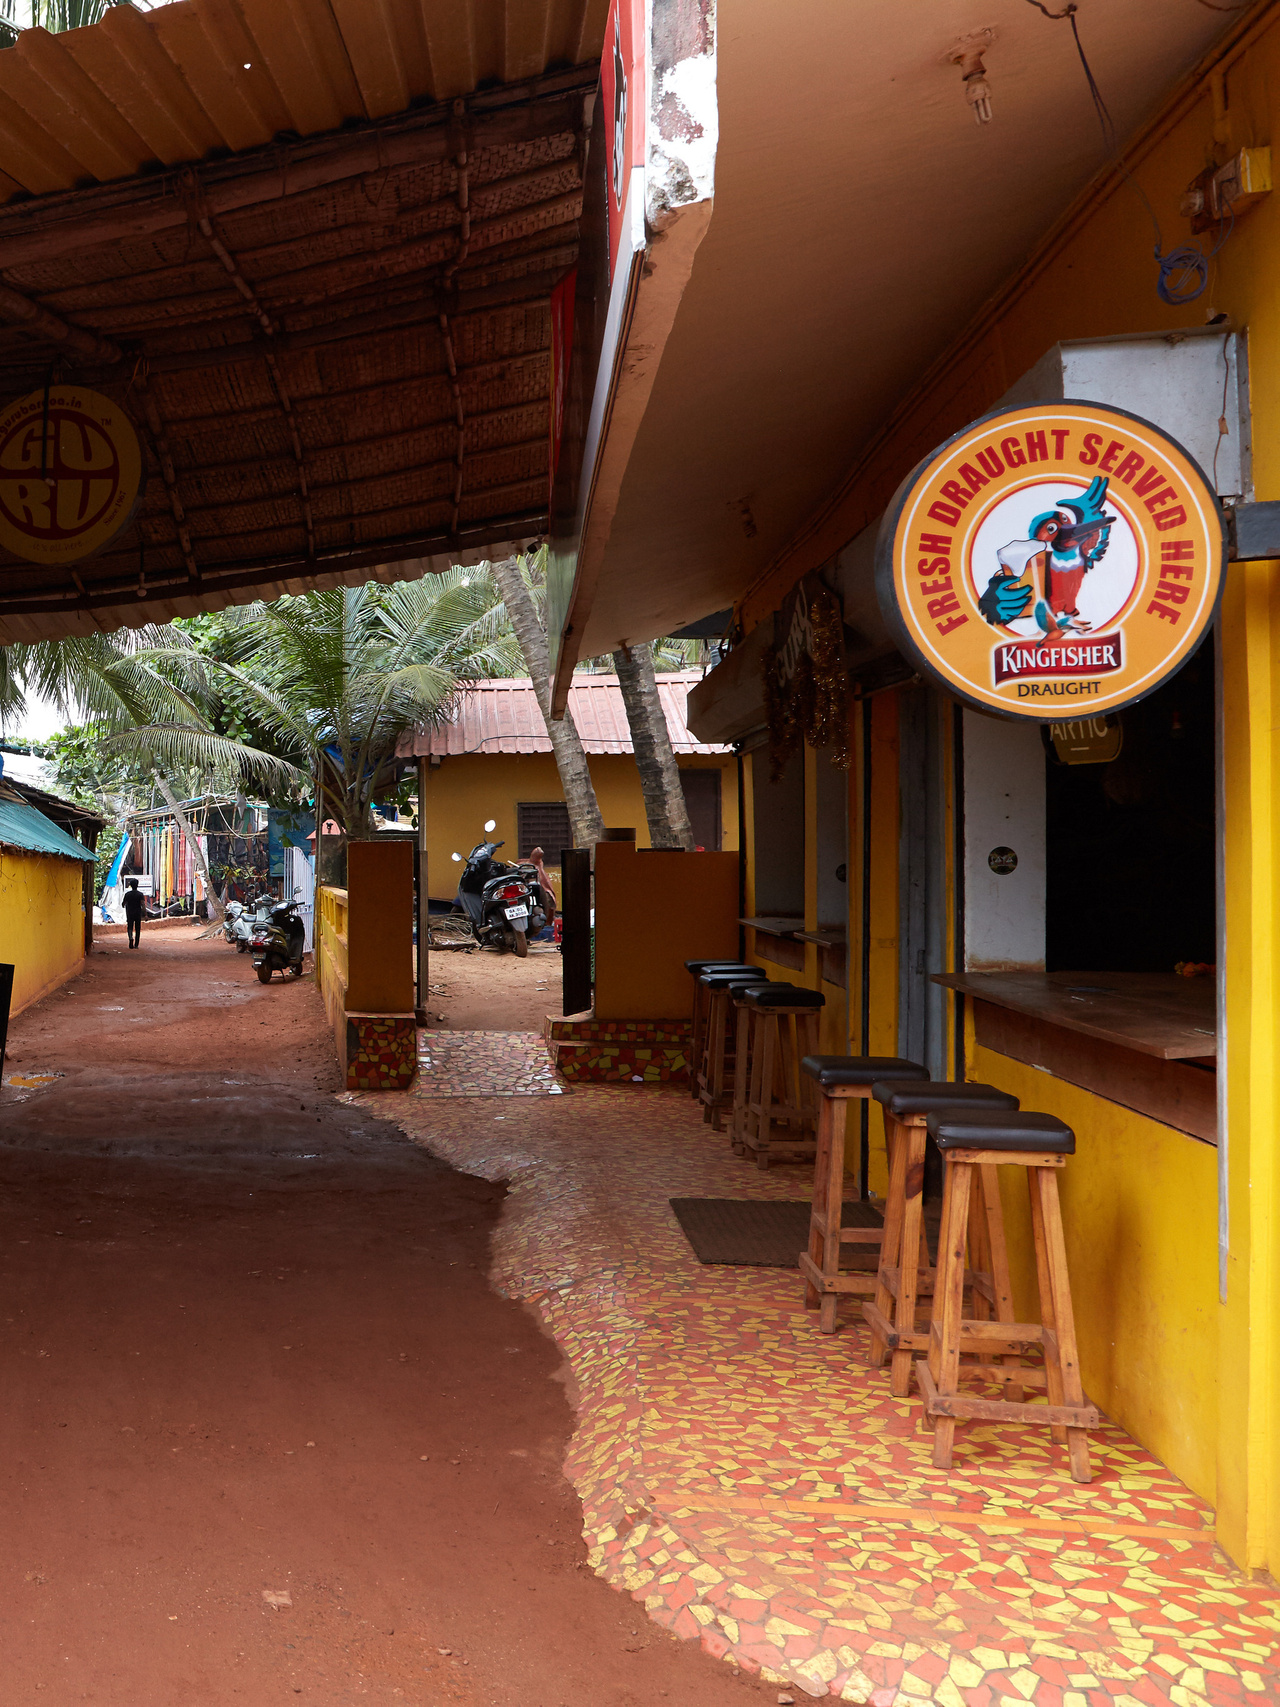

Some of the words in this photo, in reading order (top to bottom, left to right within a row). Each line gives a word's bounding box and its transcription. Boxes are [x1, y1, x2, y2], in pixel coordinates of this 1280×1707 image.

[928, 429, 1070, 527] DRAUGHT
[1078, 433, 1188, 532] SERVED
[917, 533, 969, 636] FRESH
[1145, 539, 1195, 626] HERE
[1001, 644, 1117, 673] KINGFISHER
[1018, 682, 1101, 697] DRAUGHT
